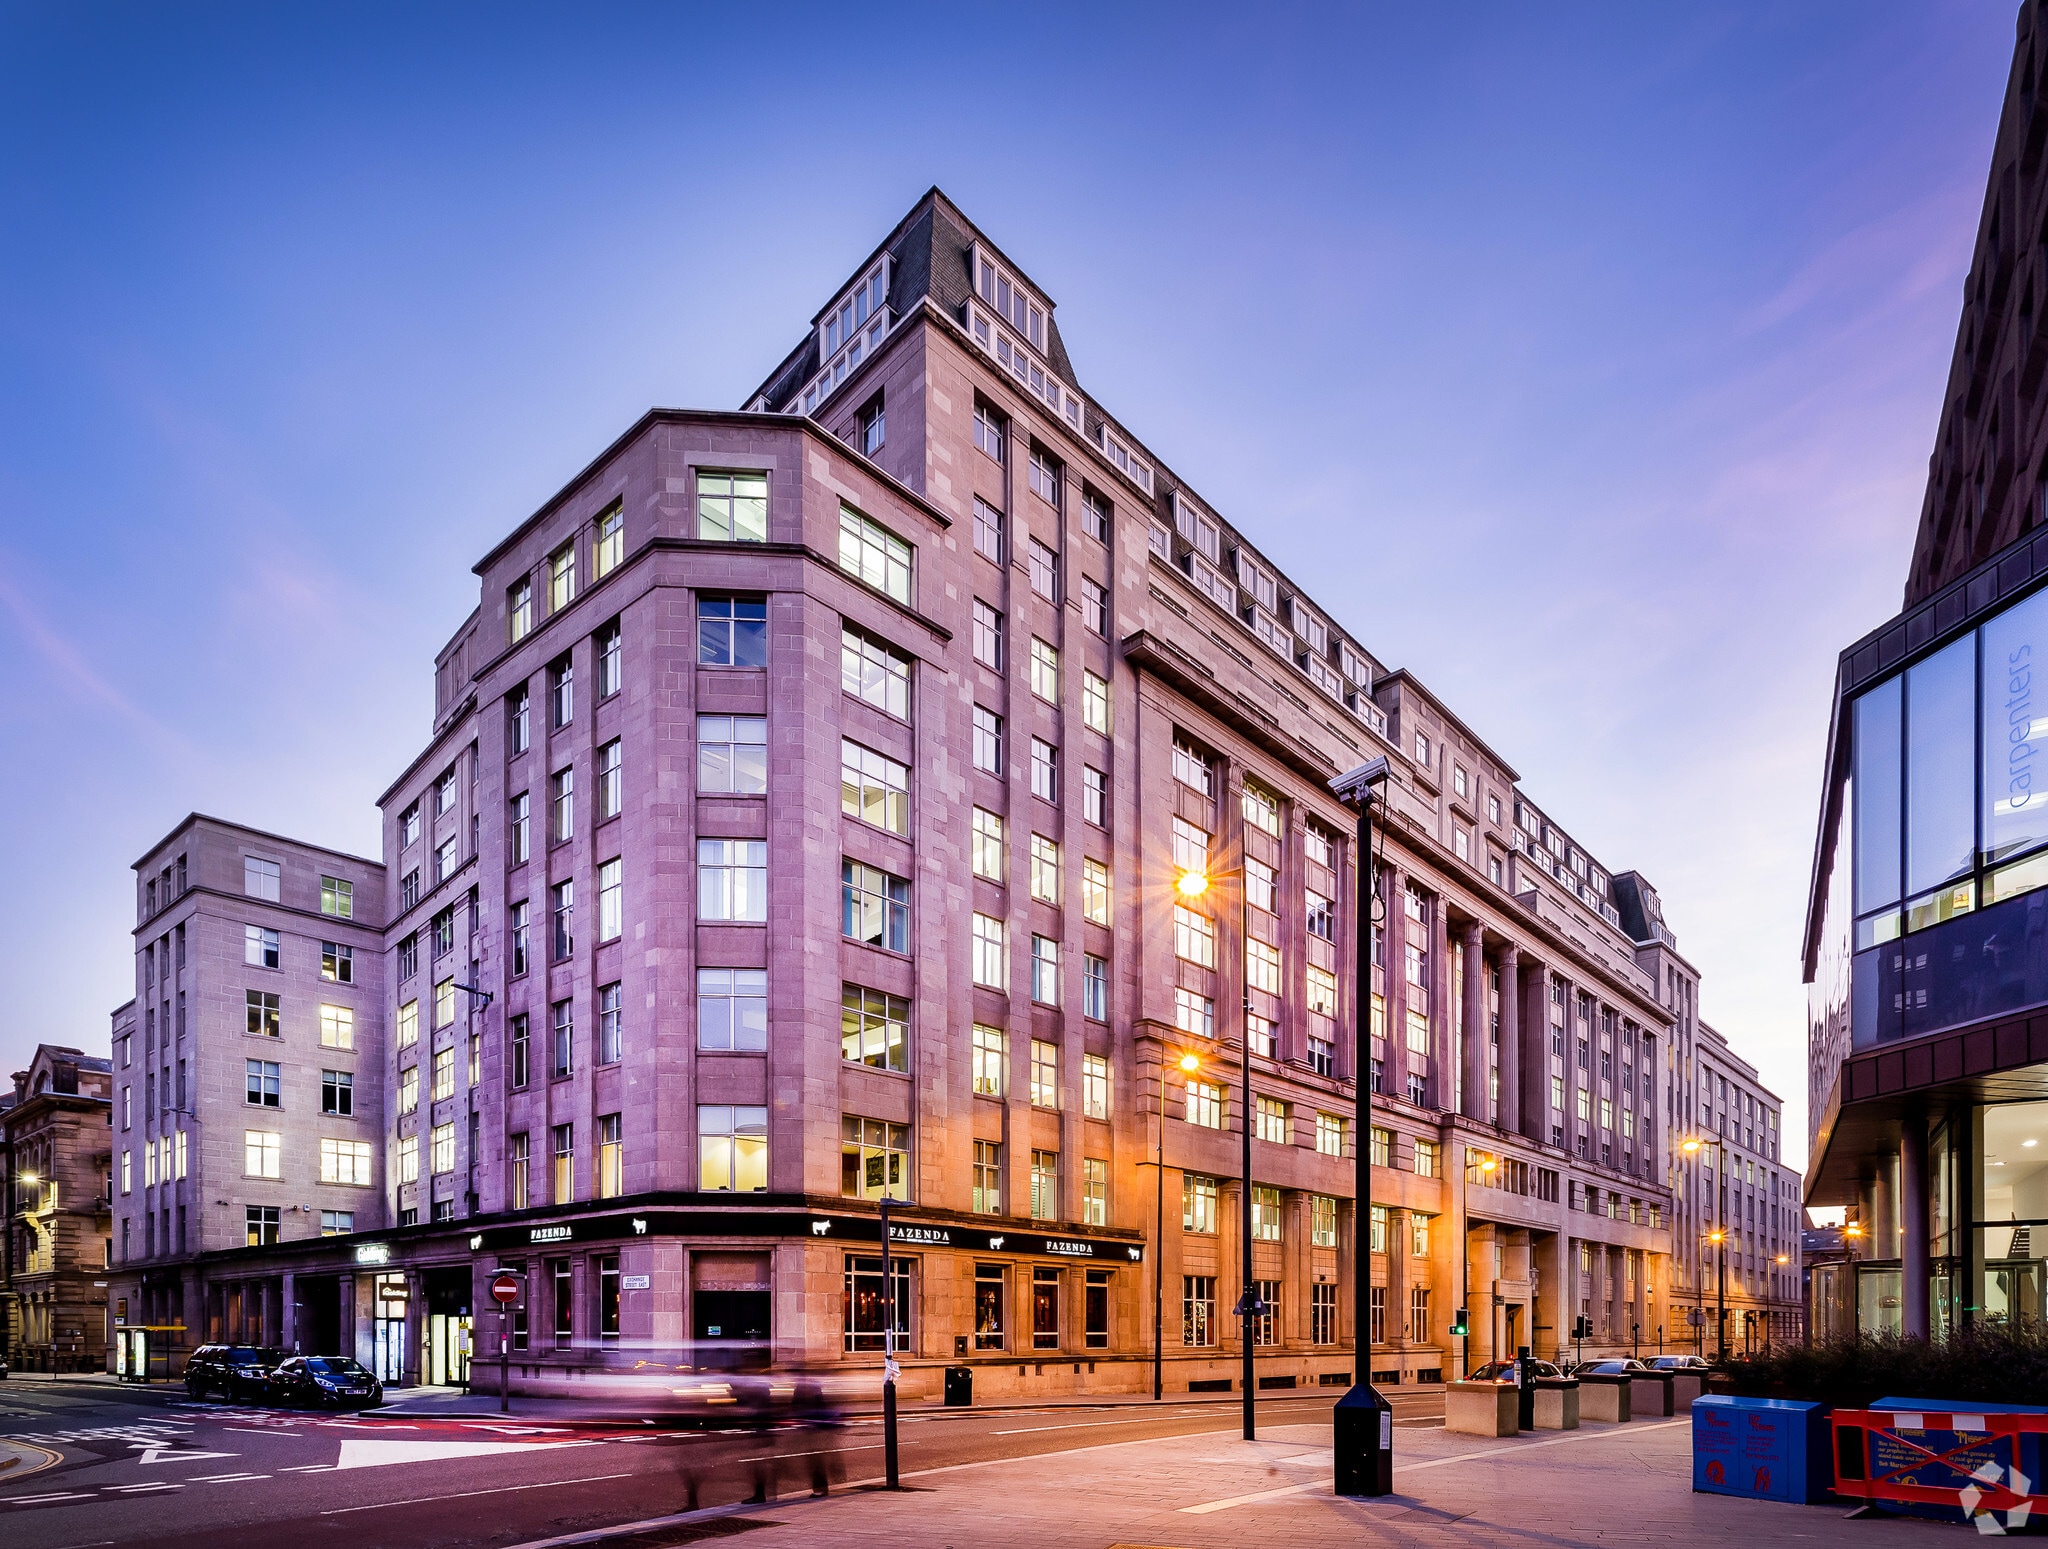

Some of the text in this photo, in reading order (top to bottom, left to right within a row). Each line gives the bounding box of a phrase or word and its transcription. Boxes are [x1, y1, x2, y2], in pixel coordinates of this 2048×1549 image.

[2005, 644, 2039, 808] carpenters
[530, 1226, 572, 1240] FAZENDA
[889, 1226, 950, 1241] FAZENDA
[1046, 1240, 1093, 1253] FAZENDA
